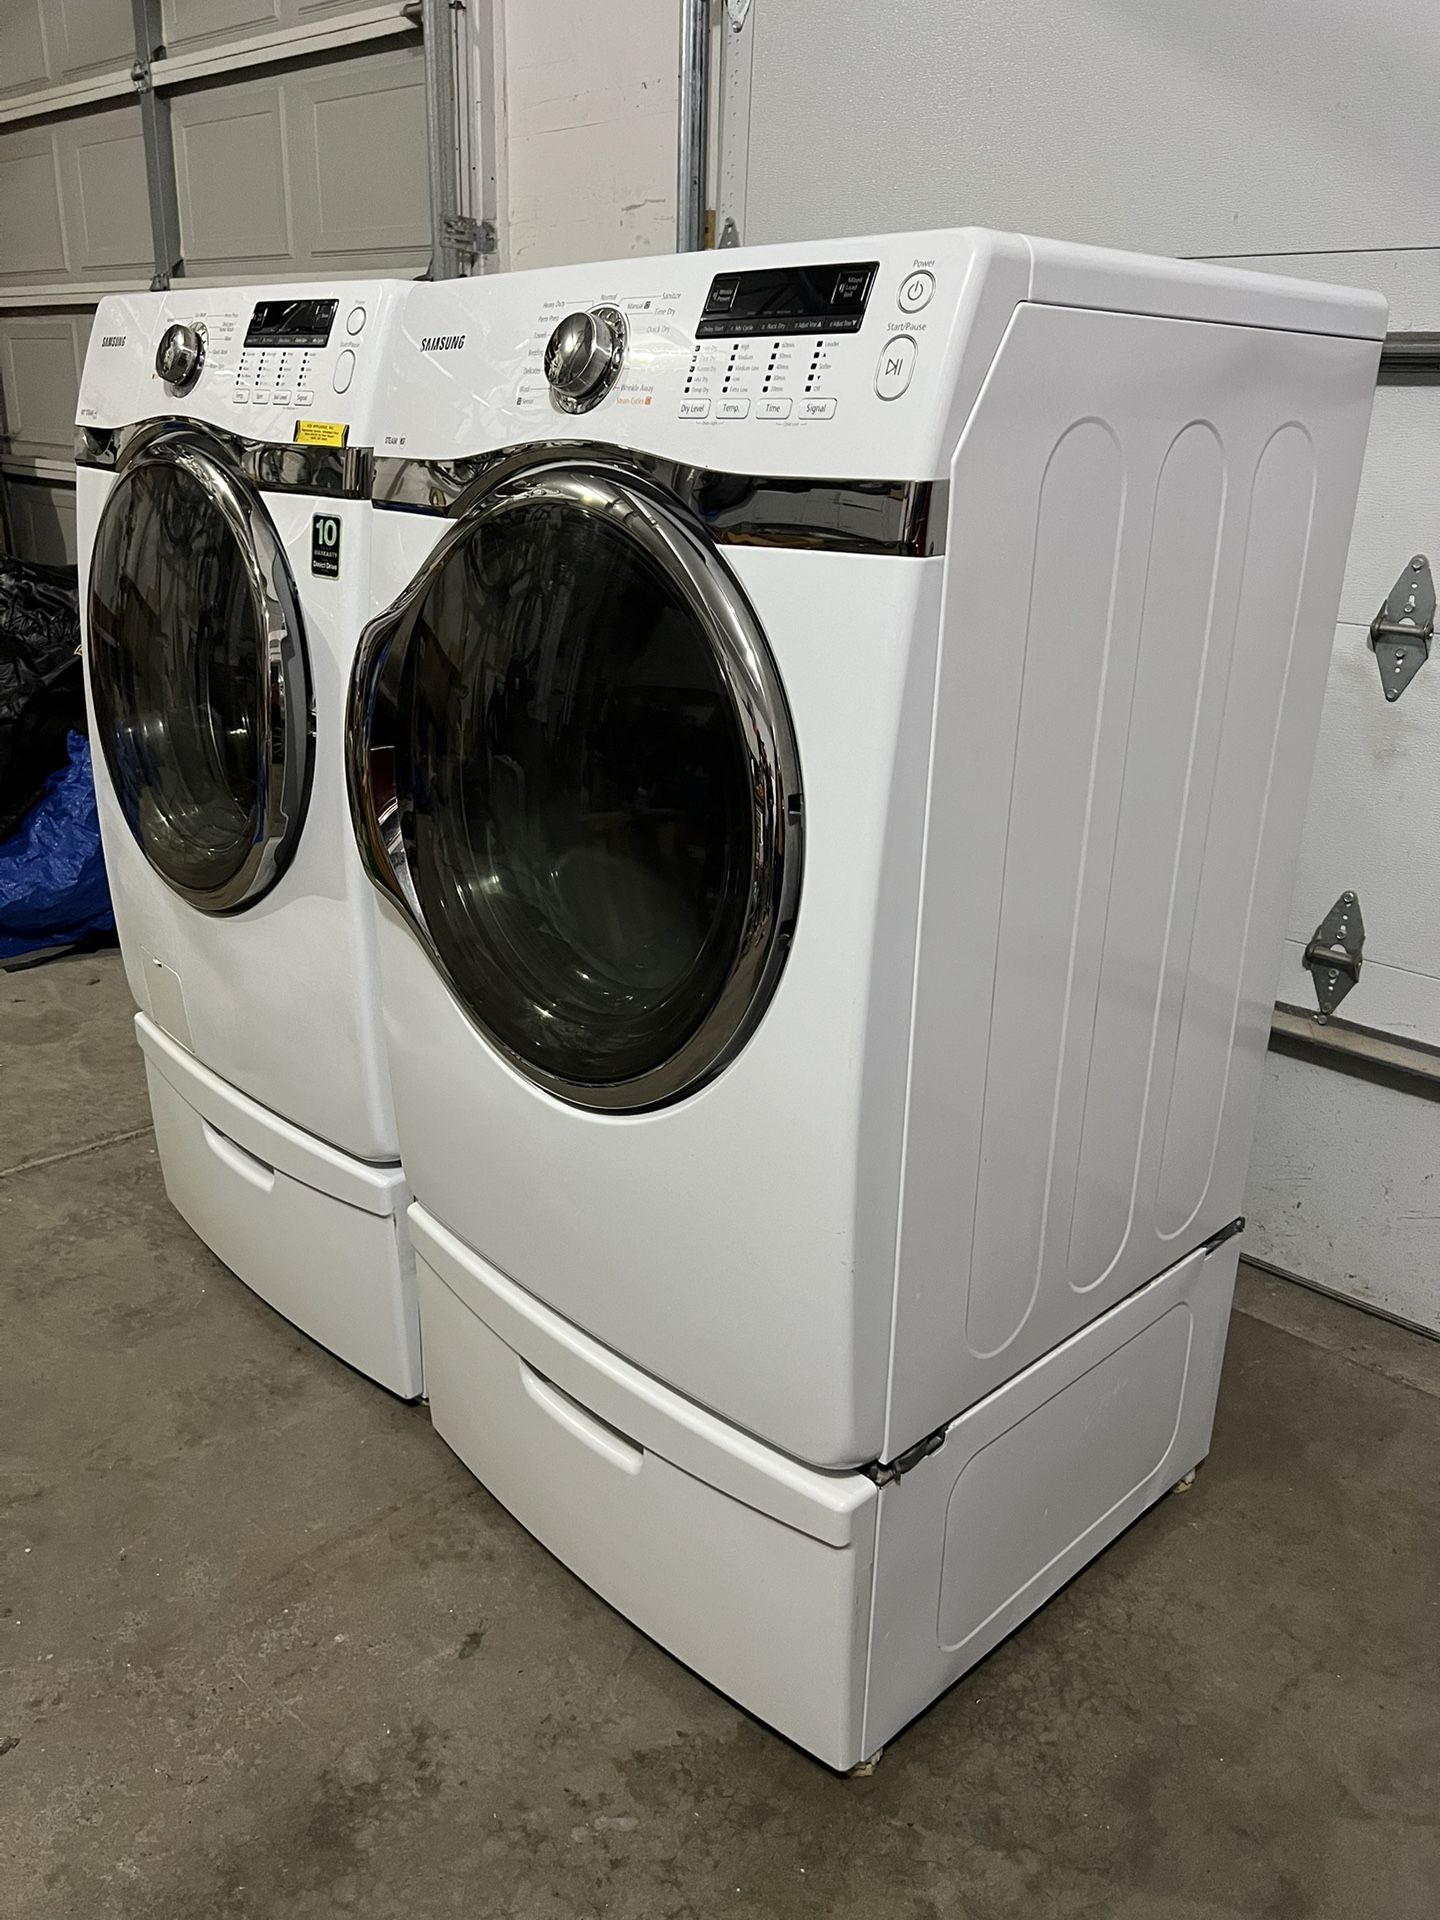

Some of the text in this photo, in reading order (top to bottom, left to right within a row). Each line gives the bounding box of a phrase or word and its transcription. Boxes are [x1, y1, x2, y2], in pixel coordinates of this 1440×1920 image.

[913, 259, 935, 268] Power
[654, 307, 676, 316] Time Dry
[661, 326, 670, 334] Dry
[887, 322, 926, 331] Start/Pause
[102, 336, 126, 347] SAMSUNG
[420, 335, 465, 352] SAMSUNG
[640, 385, 653, 393] Away
[680, 403, 705, 413] Dry Level
[723, 403, 740, 413] Temp.
[766, 403, 781, 412] Time
[806, 403, 827, 413] Signal
[315, 519, 337, 546] 10
